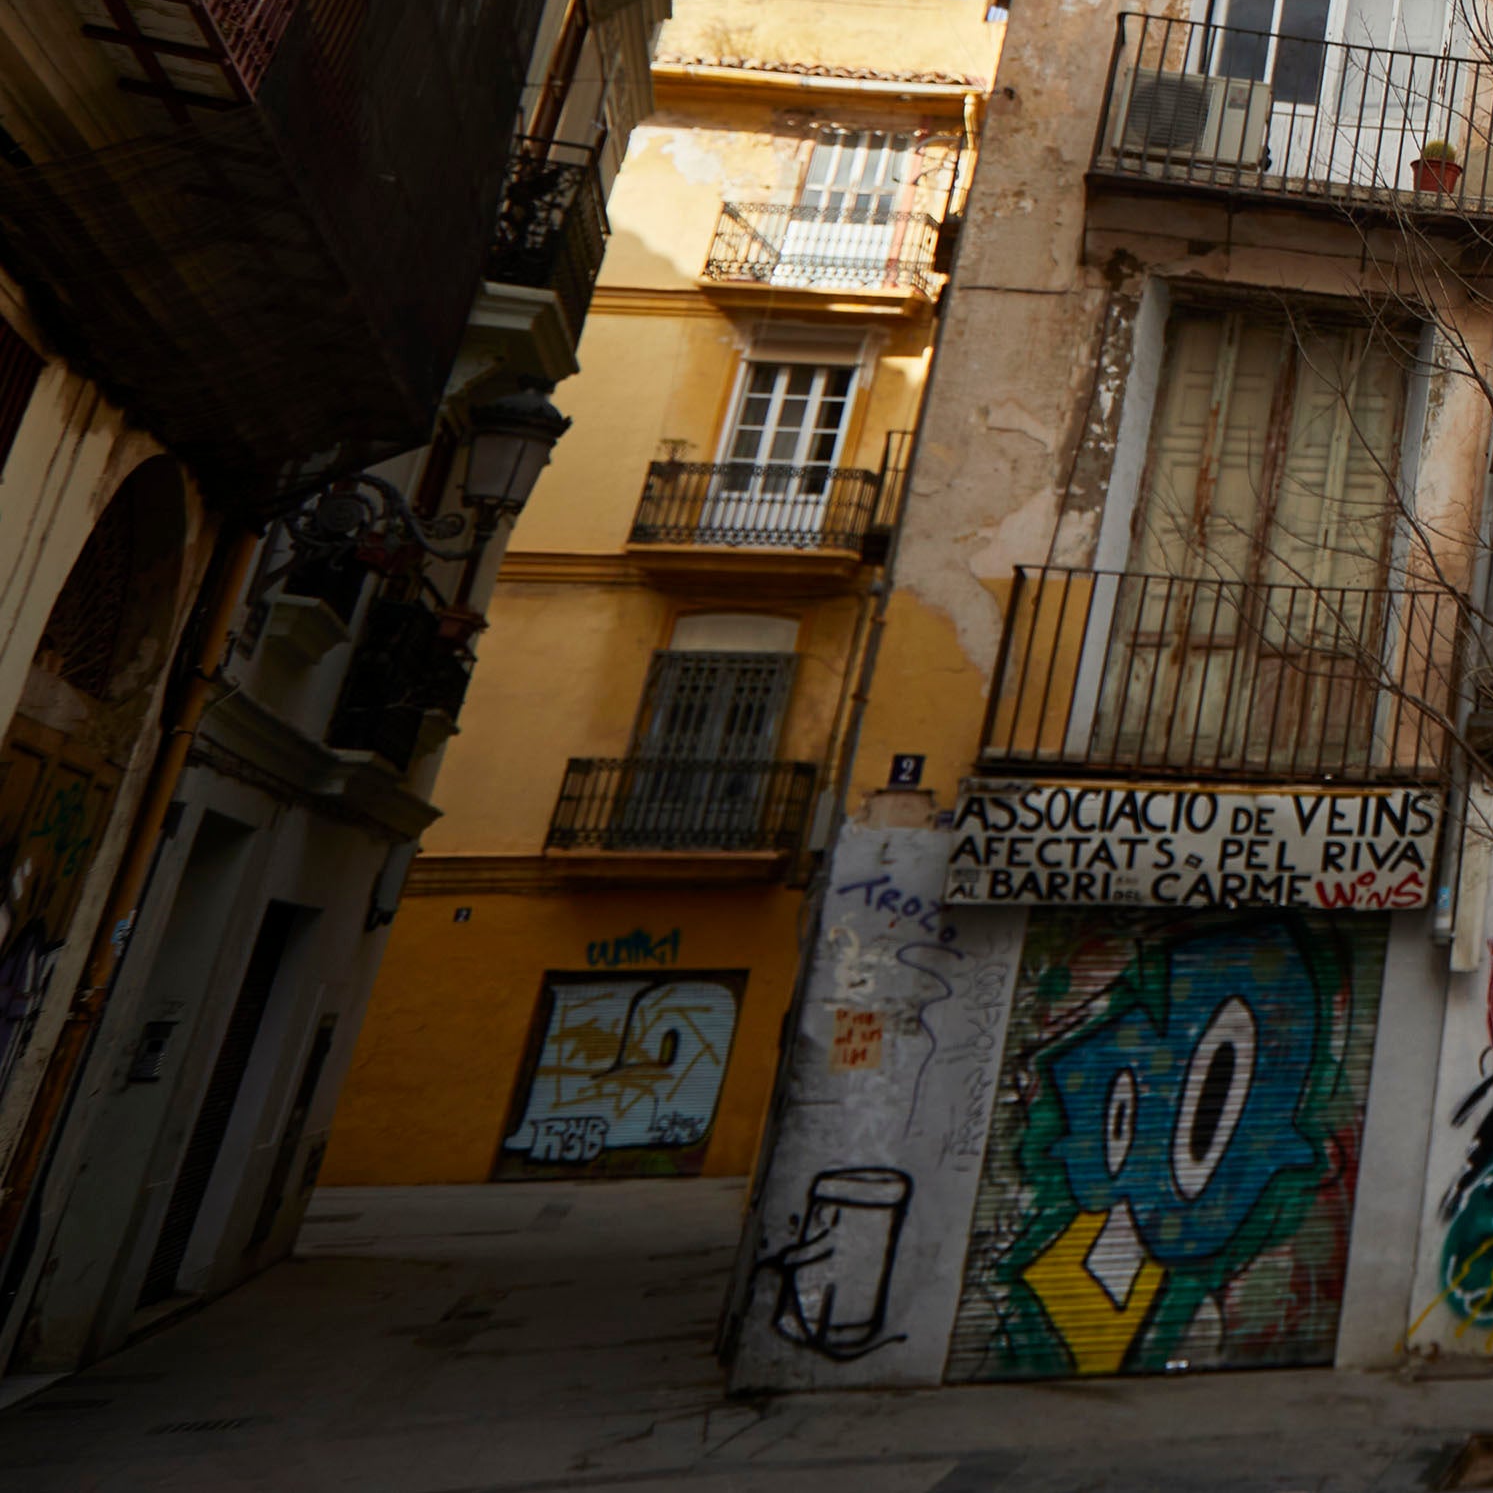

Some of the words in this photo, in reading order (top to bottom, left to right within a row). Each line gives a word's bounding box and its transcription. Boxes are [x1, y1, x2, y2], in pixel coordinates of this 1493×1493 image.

[898, 757, 915, 781] 2
[954, 787, 1218, 833] ASSOCIACIO
[1230, 807, 1275, 836] DE
[1291, 792, 1434, 837] VEINS
[950, 836, 1175, 870] AFECTATS
[1218, 839, 1295, 872] PEL
[1321, 840, 1425, 873] RIVA
[987, 871, 1112, 902] BARRI
[1152, 872, 1312, 906] CARME
